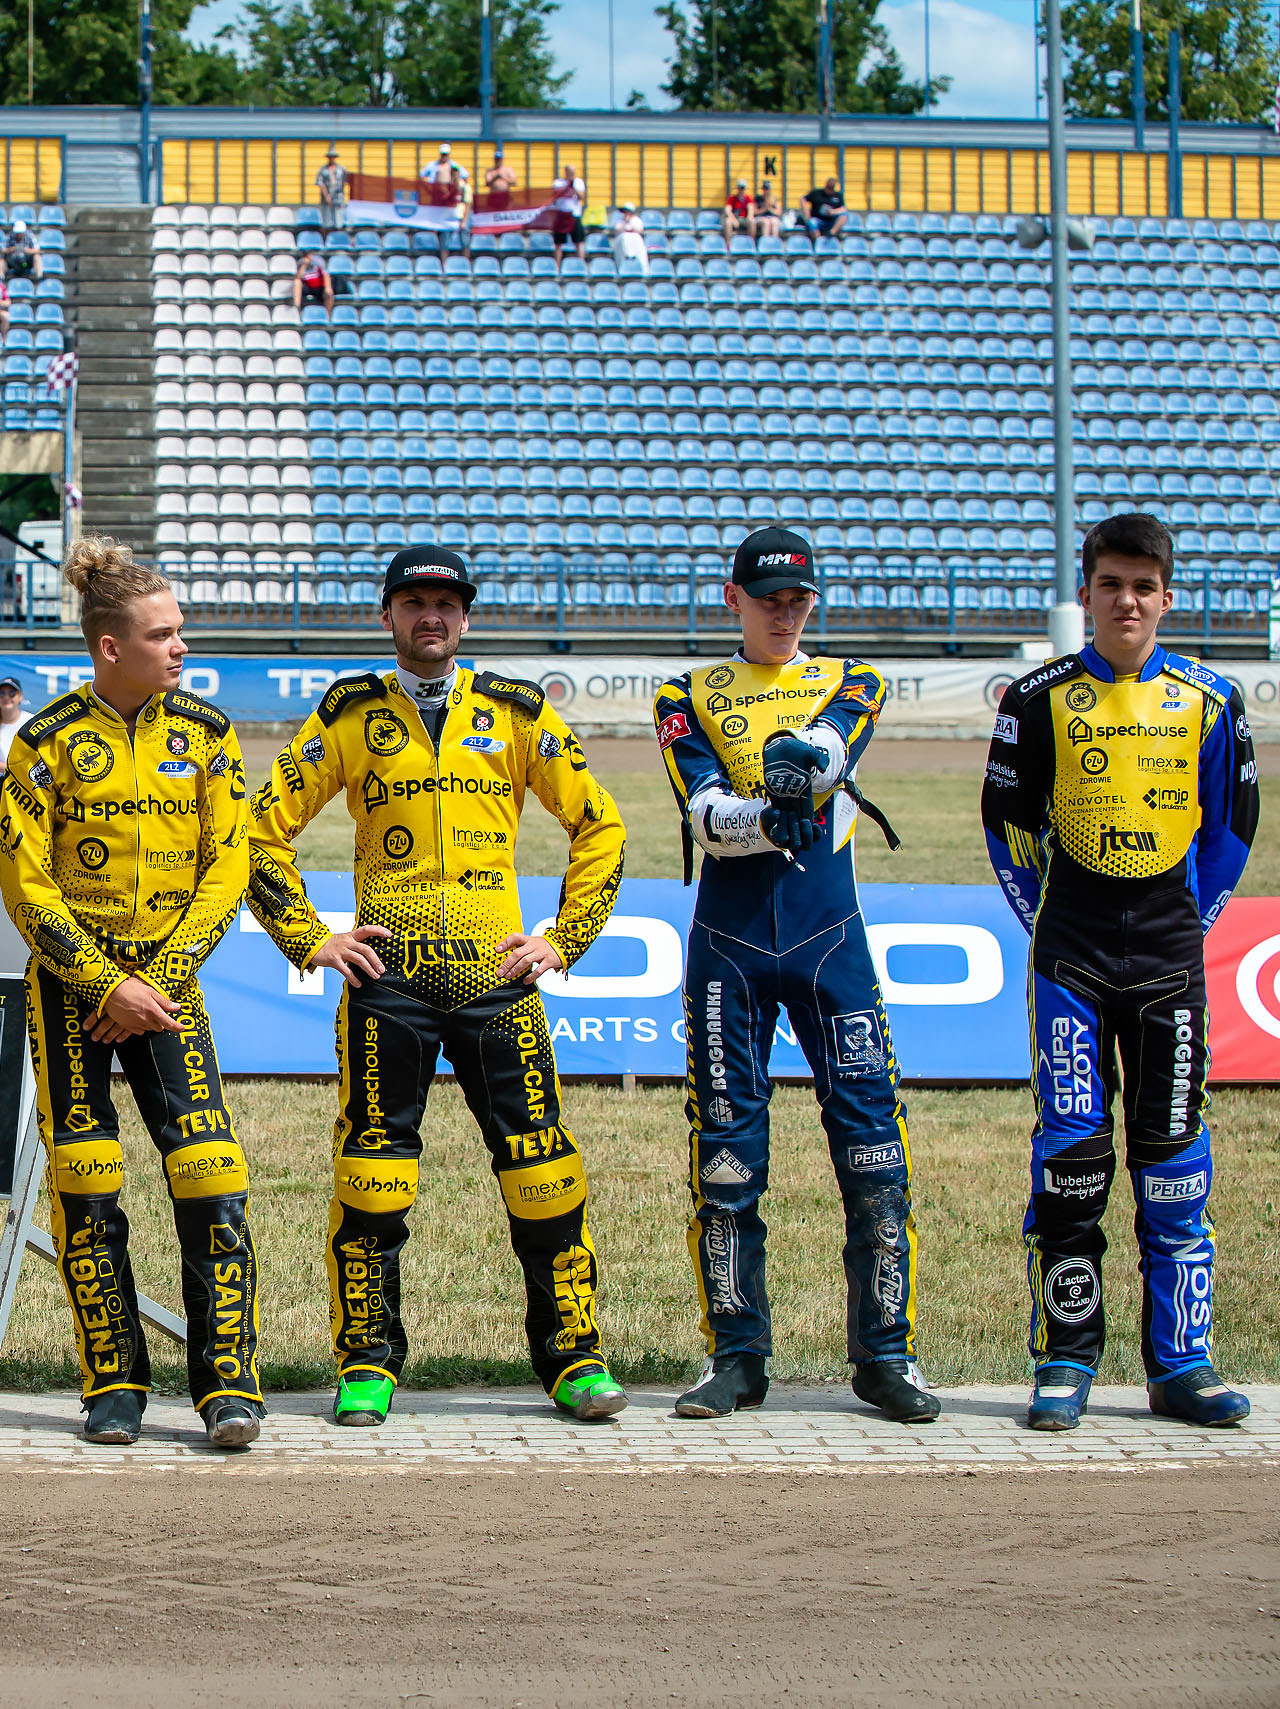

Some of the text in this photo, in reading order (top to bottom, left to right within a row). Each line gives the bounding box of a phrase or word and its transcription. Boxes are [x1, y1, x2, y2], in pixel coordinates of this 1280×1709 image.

[764, 156, 777, 176] K
[1019, 661, 1074, 694] CANAL+
[1189, 669, 1212, 682] LOTTO
[325, 682, 373, 713] BUDMAR
[488, 679, 542, 705] BUDMAR
[735, 687, 829, 708] spechouse
[28, 701, 83, 738] BUDMAR
[172, 695, 227, 727] BUDMAR
[726, 720, 743, 732] PZU
[1096, 722, 1189, 740] spechouse
[723, 736, 752, 750] ZDROWIE
[1086, 757, 1103, 768] PZU
[1137, 754, 1173, 768] Imex
[392, 772, 512, 801] spechouse
[1079, 775, 1112, 785] ZDROWIE
[1068, 794, 1127, 807] NOVOTEL
[1161, 788, 1189, 804] mjp
[91, 794, 197, 822] spechous
[1094, 805, 1126, 813] CENTRUM
[389, 834, 408, 850] PZU
[452, 826, 493, 844] Imex
[83, 846, 102, 862] PZU
[145, 847, 185, 863] Imex
[382, 860, 419, 871] ZDROWIE
[72, 868, 111, 883] ZDROWIE
[477, 869, 504, 886] mjp
[373, 882, 436, 895] NOVOTEL
[400, 893, 436, 902] CENTRUM
[63, 891, 129, 909] NOVOTEL
[164, 889, 191, 907] mjp
[90, 906, 129, 917] CENTRUM
[25, 918, 87, 972] WIERZBAK
[706, 981, 727, 1091] BOGDANKA
[177, 1002, 211, 1102] POL-CAR
[363, 1016, 385, 1126] spechouse
[513, 1015, 546, 1122] POL-CAR
[1169, 1008, 1193, 1137] BOGDANKA
[176, 1108, 228, 1139] TEY!
[505, 1127, 563, 1161] TEY!
[177, 1156, 217, 1175] Imex
[699, 1148, 752, 1181] LEROY MERLIN
[853, 1148, 900, 1166] PERŁA
[347, 1175, 410, 1193] Kubota
[1055, 1171, 1106, 1187] lubelskie
[1150, 1177, 1204, 1197] PERŁA
[519, 1180, 560, 1199] Imex
[94, 1219, 129, 1334] HOLDING
[1057, 1273, 1091, 1287] Lactex
[67, 1228, 120, 1375] ENERGIA
[339, 1239, 370, 1350] ENERGIA
[1059, 1296, 1091, 1308] POLAND
[212, 1262, 243, 1380] SANTO
